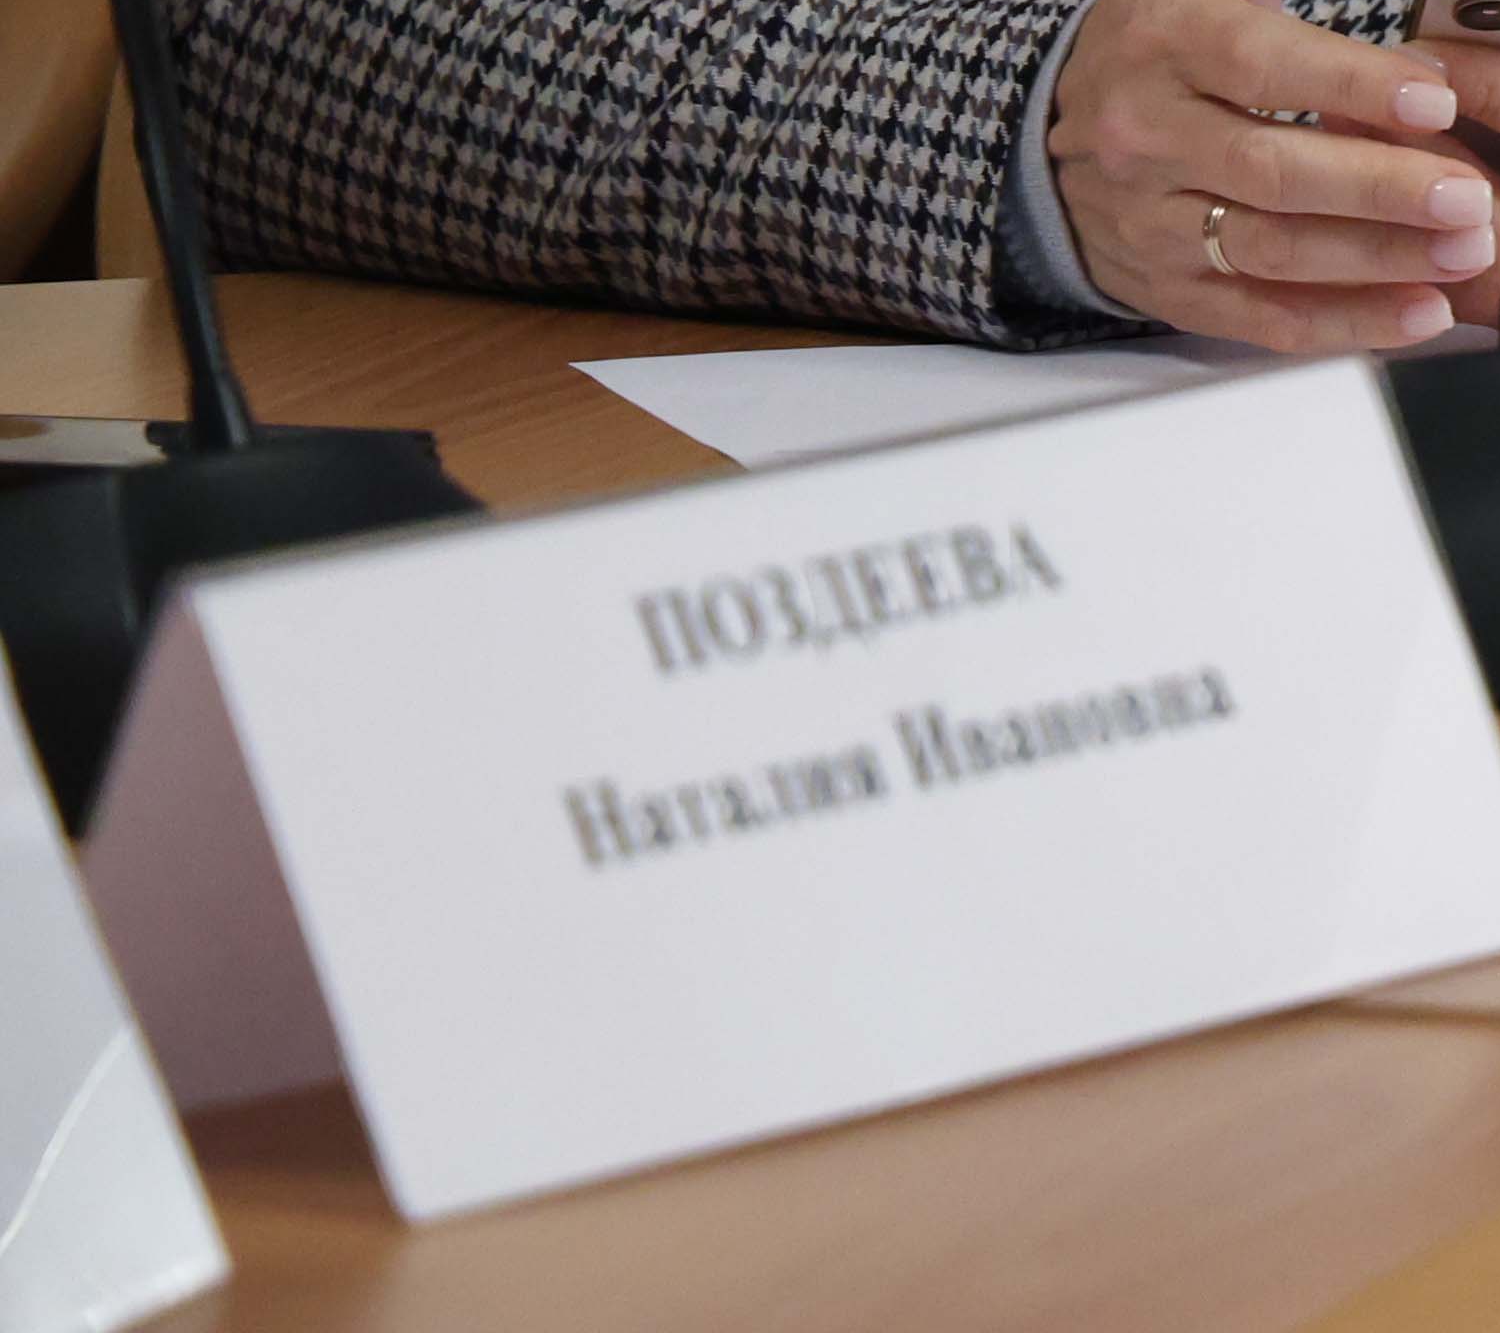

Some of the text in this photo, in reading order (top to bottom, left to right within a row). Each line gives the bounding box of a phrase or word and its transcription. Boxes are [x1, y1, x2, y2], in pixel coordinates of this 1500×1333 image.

[635, 519, 1064, 675] ПОЗДЕЕВА
[563, 665, 1235, 868] Наталия Ивановна
